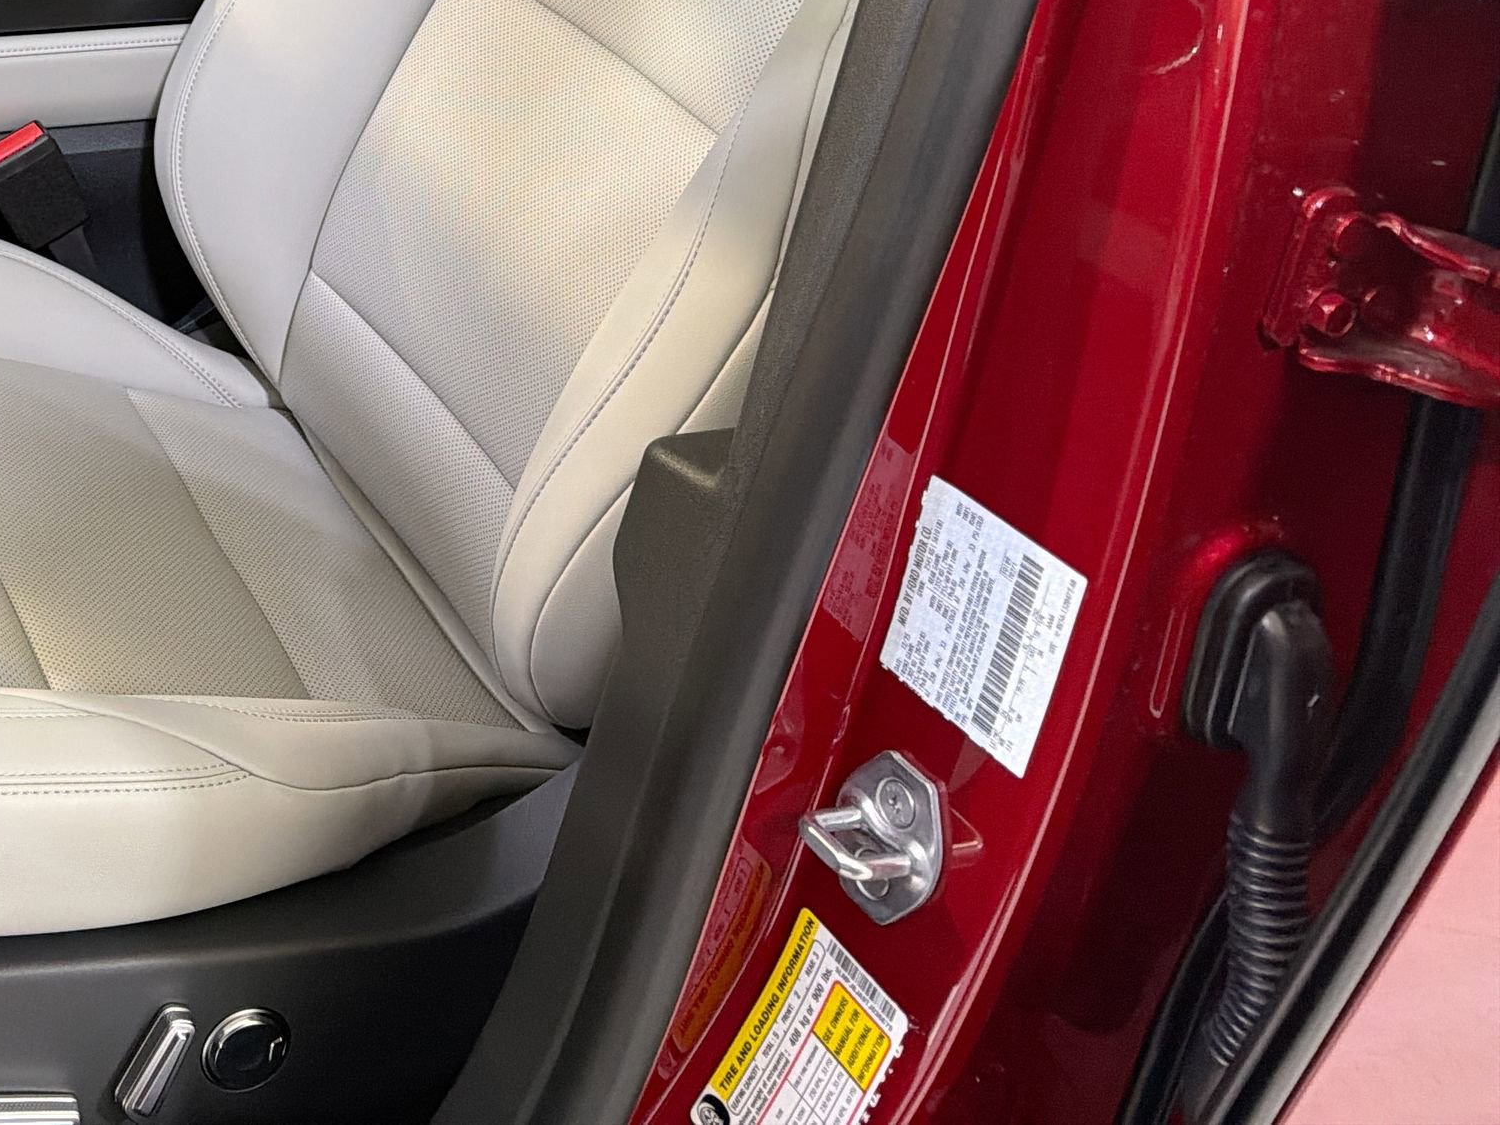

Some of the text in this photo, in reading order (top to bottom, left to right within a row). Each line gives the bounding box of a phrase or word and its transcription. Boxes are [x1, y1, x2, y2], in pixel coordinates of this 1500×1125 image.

[898, 526, 932, 626] MFD. BY FORD MOTOR CO.
[719, 918, 814, 1090] TIRE AND LOADING INFORMATION
[789, 1028, 801, 1046] 408
[798, 1015, 810, 1028] kg
[806, 1004, 814, 1016] or
[812, 983, 824, 1002] 900
[822, 997, 848, 1044] SEE OWNERS
[834, 1009, 860, 1056] MANUAL FOR
[847, 1025, 871, 1068] ADDITIONAL
[857, 1030, 885, 1082] INFORMATION
